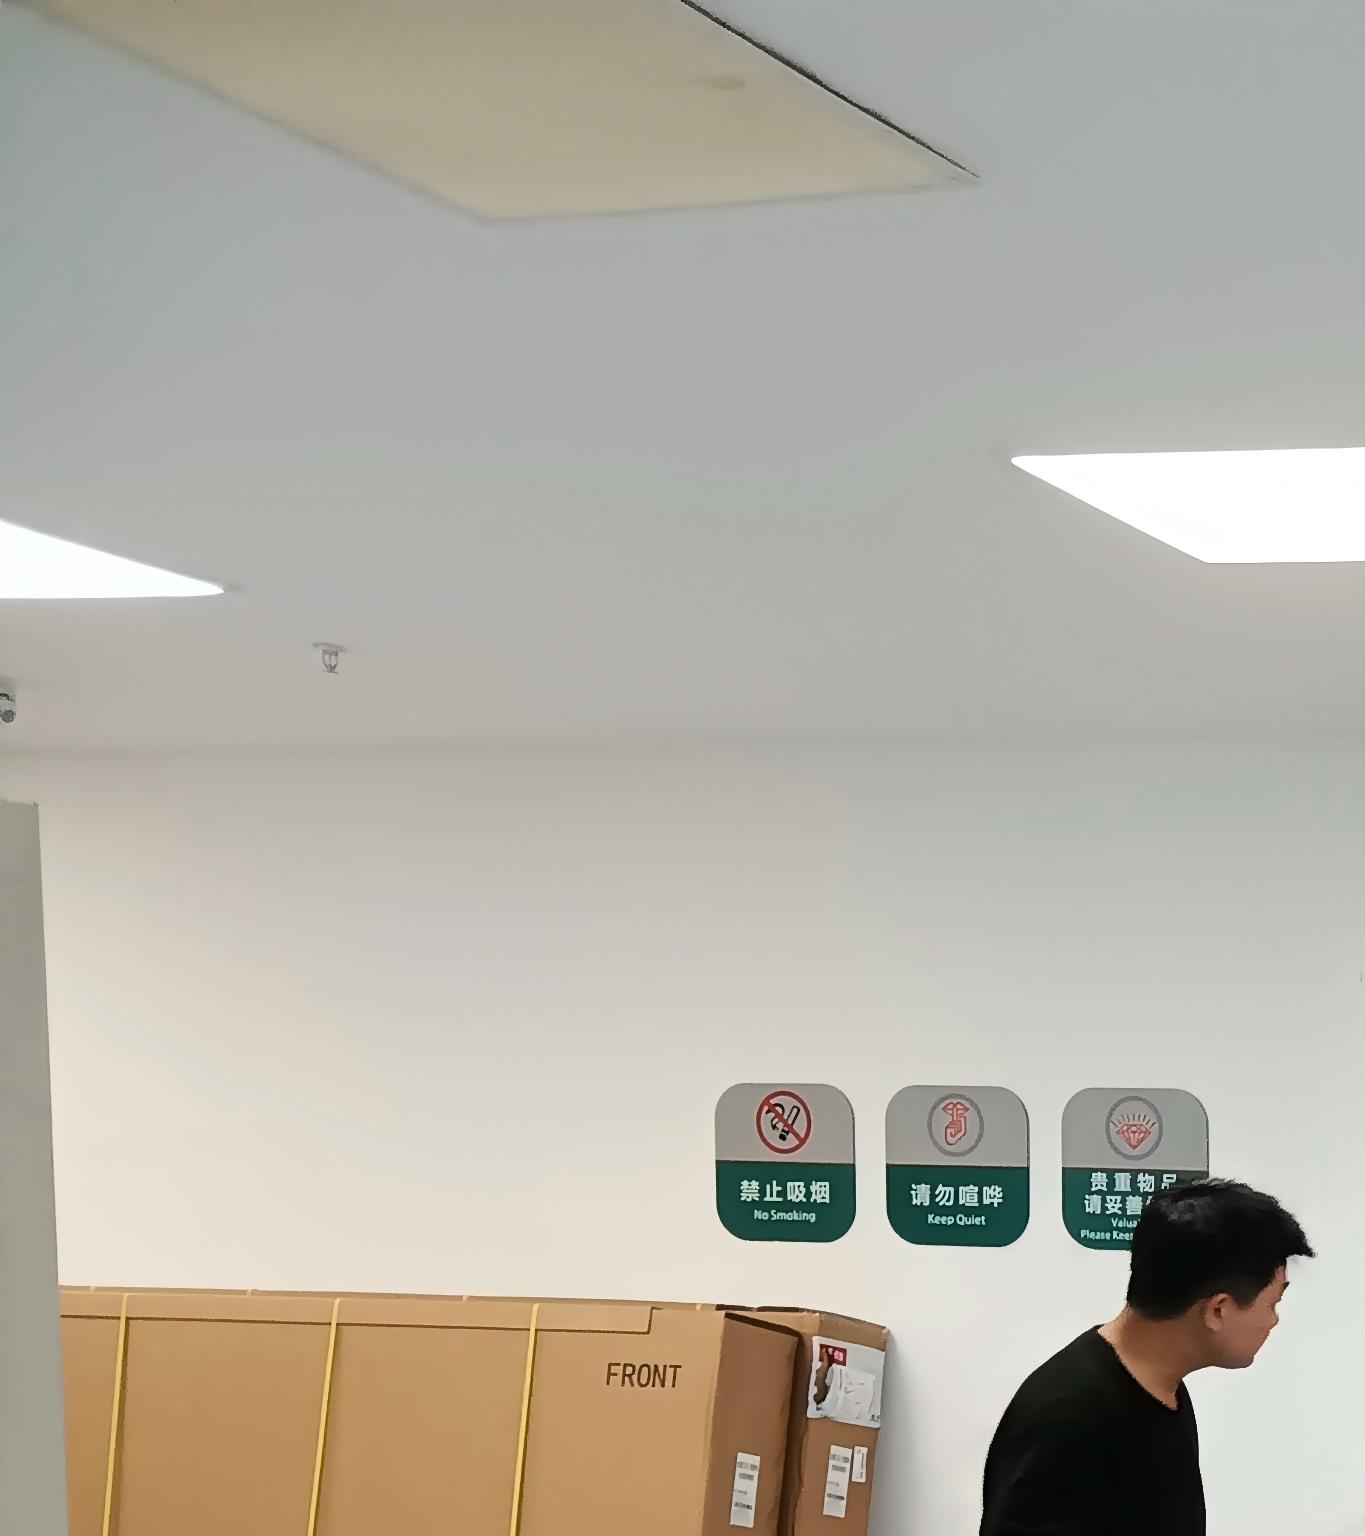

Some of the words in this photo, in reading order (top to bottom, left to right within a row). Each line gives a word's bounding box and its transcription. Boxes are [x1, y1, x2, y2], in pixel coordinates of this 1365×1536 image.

[740, 1180, 830, 1203] 禁止吸烟
[910, 1183, 1003, 1207] 请勿喧哗
[1084, 1194, 1153, 1215] 请妥善
[753, 1209, 769, 1220] No
[770, 1209, 816, 1223] Smoking
[927, 1213, 955, 1226] Keep
[956, 1213, 986, 1226] Quiet
[606, 1362, 682, 1389] FRONT
